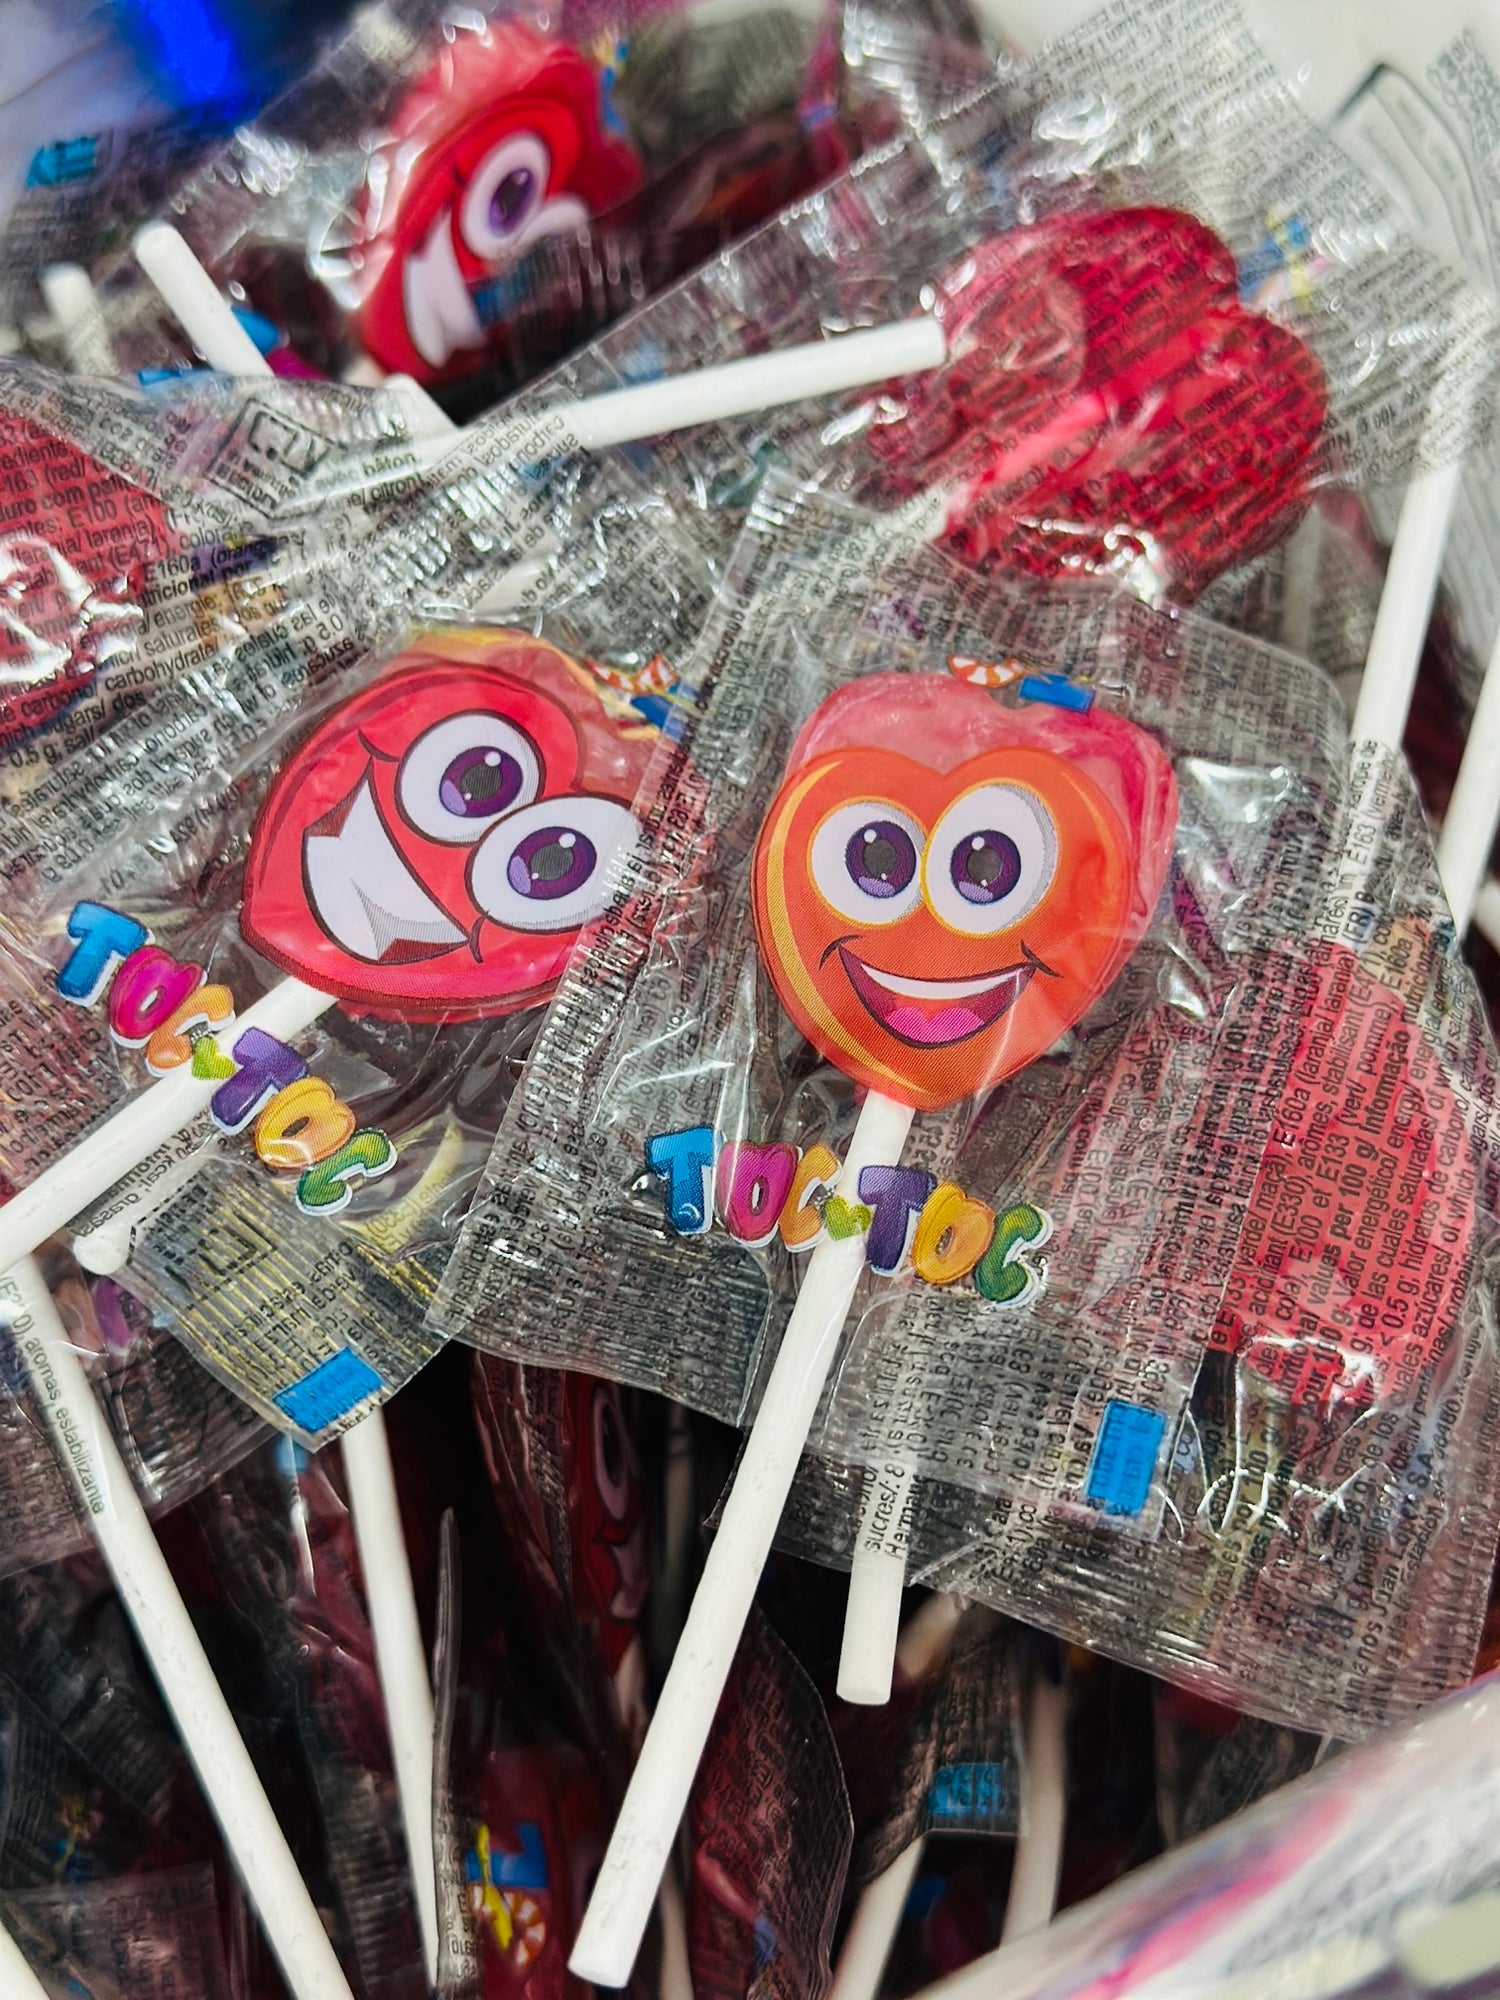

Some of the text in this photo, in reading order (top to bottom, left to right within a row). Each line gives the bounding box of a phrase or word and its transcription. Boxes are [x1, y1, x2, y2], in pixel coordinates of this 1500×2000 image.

[39, 482, 84, 509] com
[43, 455, 87, 490] (red/
[66, 498, 118, 529] E100
[140, 548, 202, 582] E160a
[1341, 903, 1376, 945] (FR)
[1346, 943, 1389, 1009] (E471),
[56, 900, 237, 1078] TOC
[211, 1026, 397, 1215] TOC
[1293, 1012, 1340, 1086] (laranja/
[1317, 1005, 1367, 1097] stabilisant
[1360, 1025, 1417, 1136] Informação
[1270, 934, 1414, 1323] cola), E100 et E133 (vert/ pomme), E160a
[1271, 1085, 1312, 1148] E160a
[1290, 1093, 1339, 1170] arômes,
[1350, 1135, 1381, 1162] g/
[1383, 1080, 1429, 1151] energy/
[1434, 1090, 1472, 1168] carbono/
[1253, 1147, 1295, 1213] maçã),
[1268, 1167, 1315, 1238] (E330),
[1337, 1162, 1368, 1201] 100
[1348, 1038, 1460, 1355] g; de las cuales saturadas/ of which
[1349, 1147, 1405, 1251] energético/
[1422, 1167, 1449, 1196] de
[1443, 1166, 1478, 1220] which
[644, 1123, 1053, 1308] TOC TOC
[1232, 1210, 1271, 1277] (verde/
[1327, 1202, 1357, 1240] per
[1398, 1195, 1441, 1272] hidratos
[1435, 1217, 1461, 1245] of
[1303, 1240, 1343, 1306] values
[1332, 1249, 1368, 1300] Valor
[1394, 1272, 1421, 1297] g;
[1406, 1243, 1454, 1338] azúcares/
[1330, 1302, 1357, 1327] g:
[1376, 1331, 1397, 1349] <
[1379, 1295, 1410, 1330] 0.5
[1386, 1339, 1425, 1405] cuales
[20, 1335, 112, 1516] aromas, estabilizante
[862, 1478, 902, 1554] sucres/:
